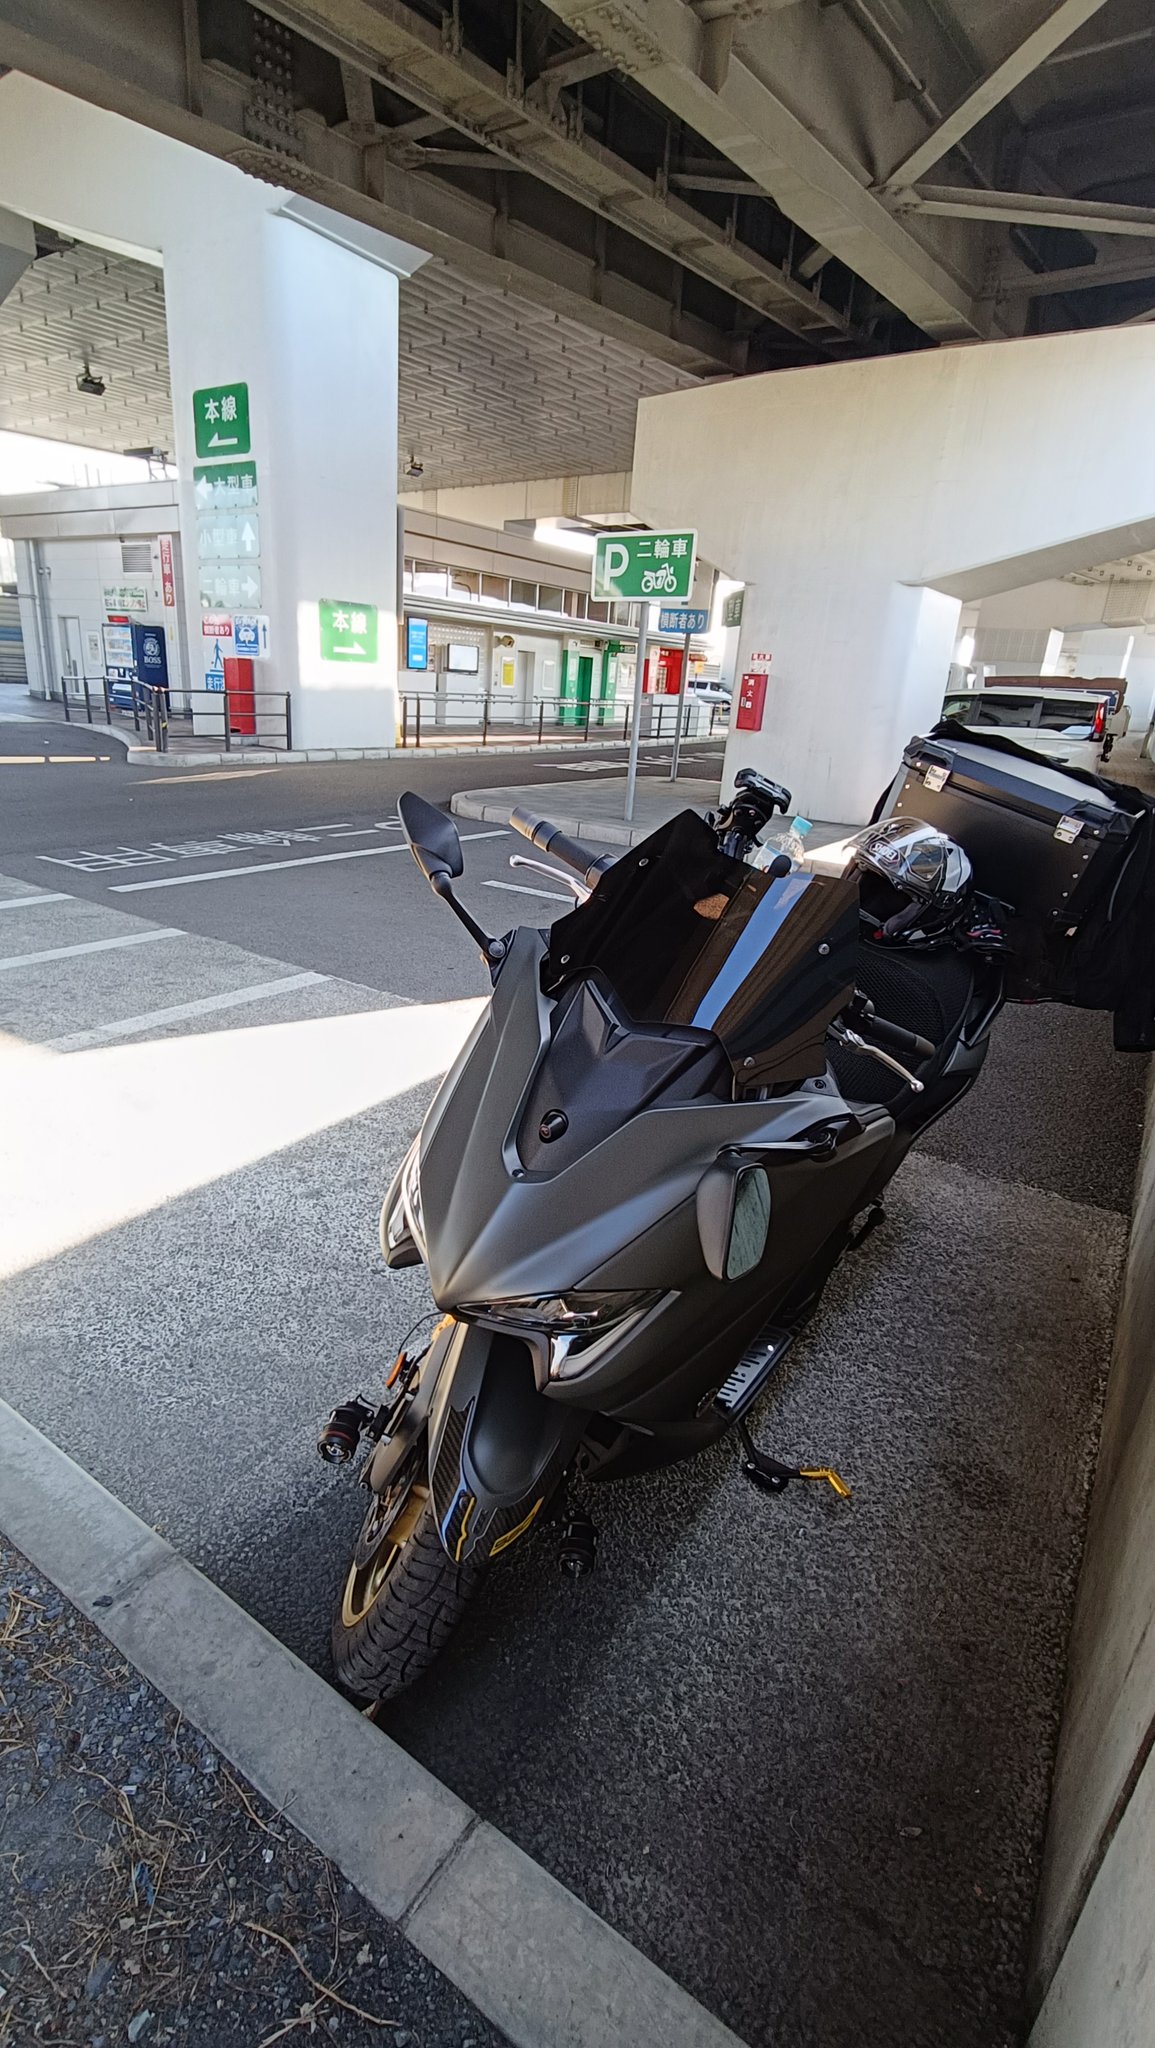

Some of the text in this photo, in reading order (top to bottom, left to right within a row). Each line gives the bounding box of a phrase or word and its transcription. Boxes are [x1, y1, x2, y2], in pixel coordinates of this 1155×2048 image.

[204, 396, 237, 424] 本線
[213, 473, 254, 496] 大型車
[199, 527, 239, 546] 小型車
[637, 538, 688, 559] 二輪車
[604, 543, 629, 592] P
[202, 579, 240, 597] 二輪車
[332, 609, 367, 634] 本線
[660, 611, 705, 629] 横断者あり
[143, 656, 161, 664] BOSS
